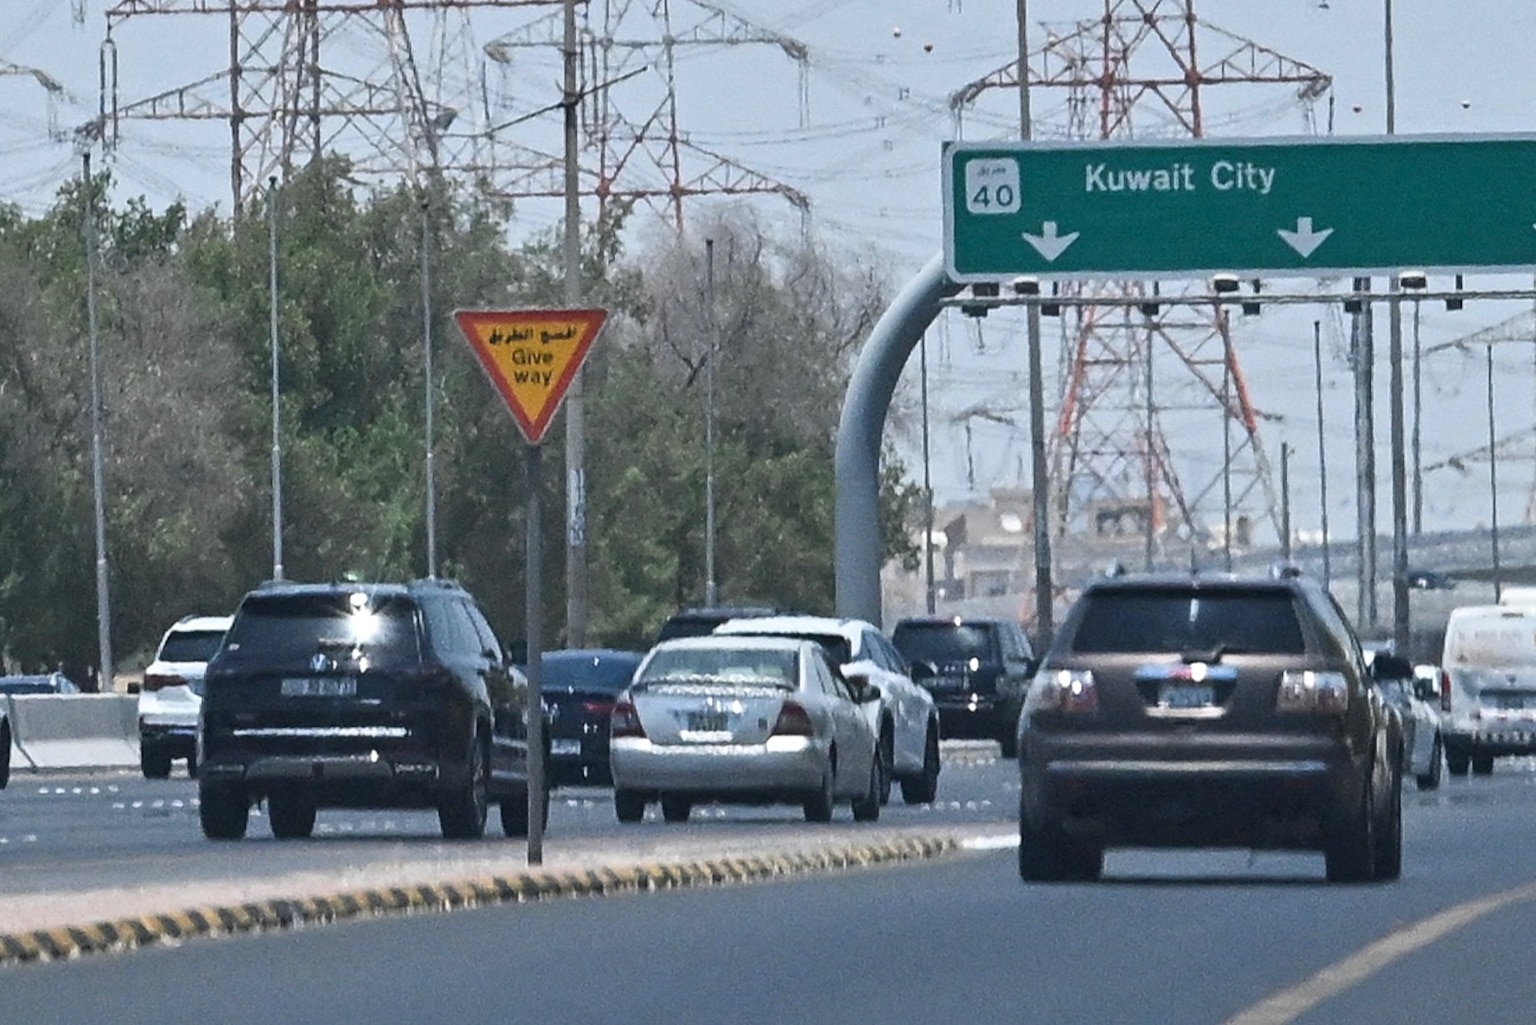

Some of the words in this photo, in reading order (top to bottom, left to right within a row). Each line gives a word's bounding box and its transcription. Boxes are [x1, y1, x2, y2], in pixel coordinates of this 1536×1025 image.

[1085, 163, 1196, 192] Kuwait
[1210, 160, 1276, 194] City
[973, 184, 1013, 207] 40
[511, 349, 554, 365] Give
[513, 371, 552, 387] way
